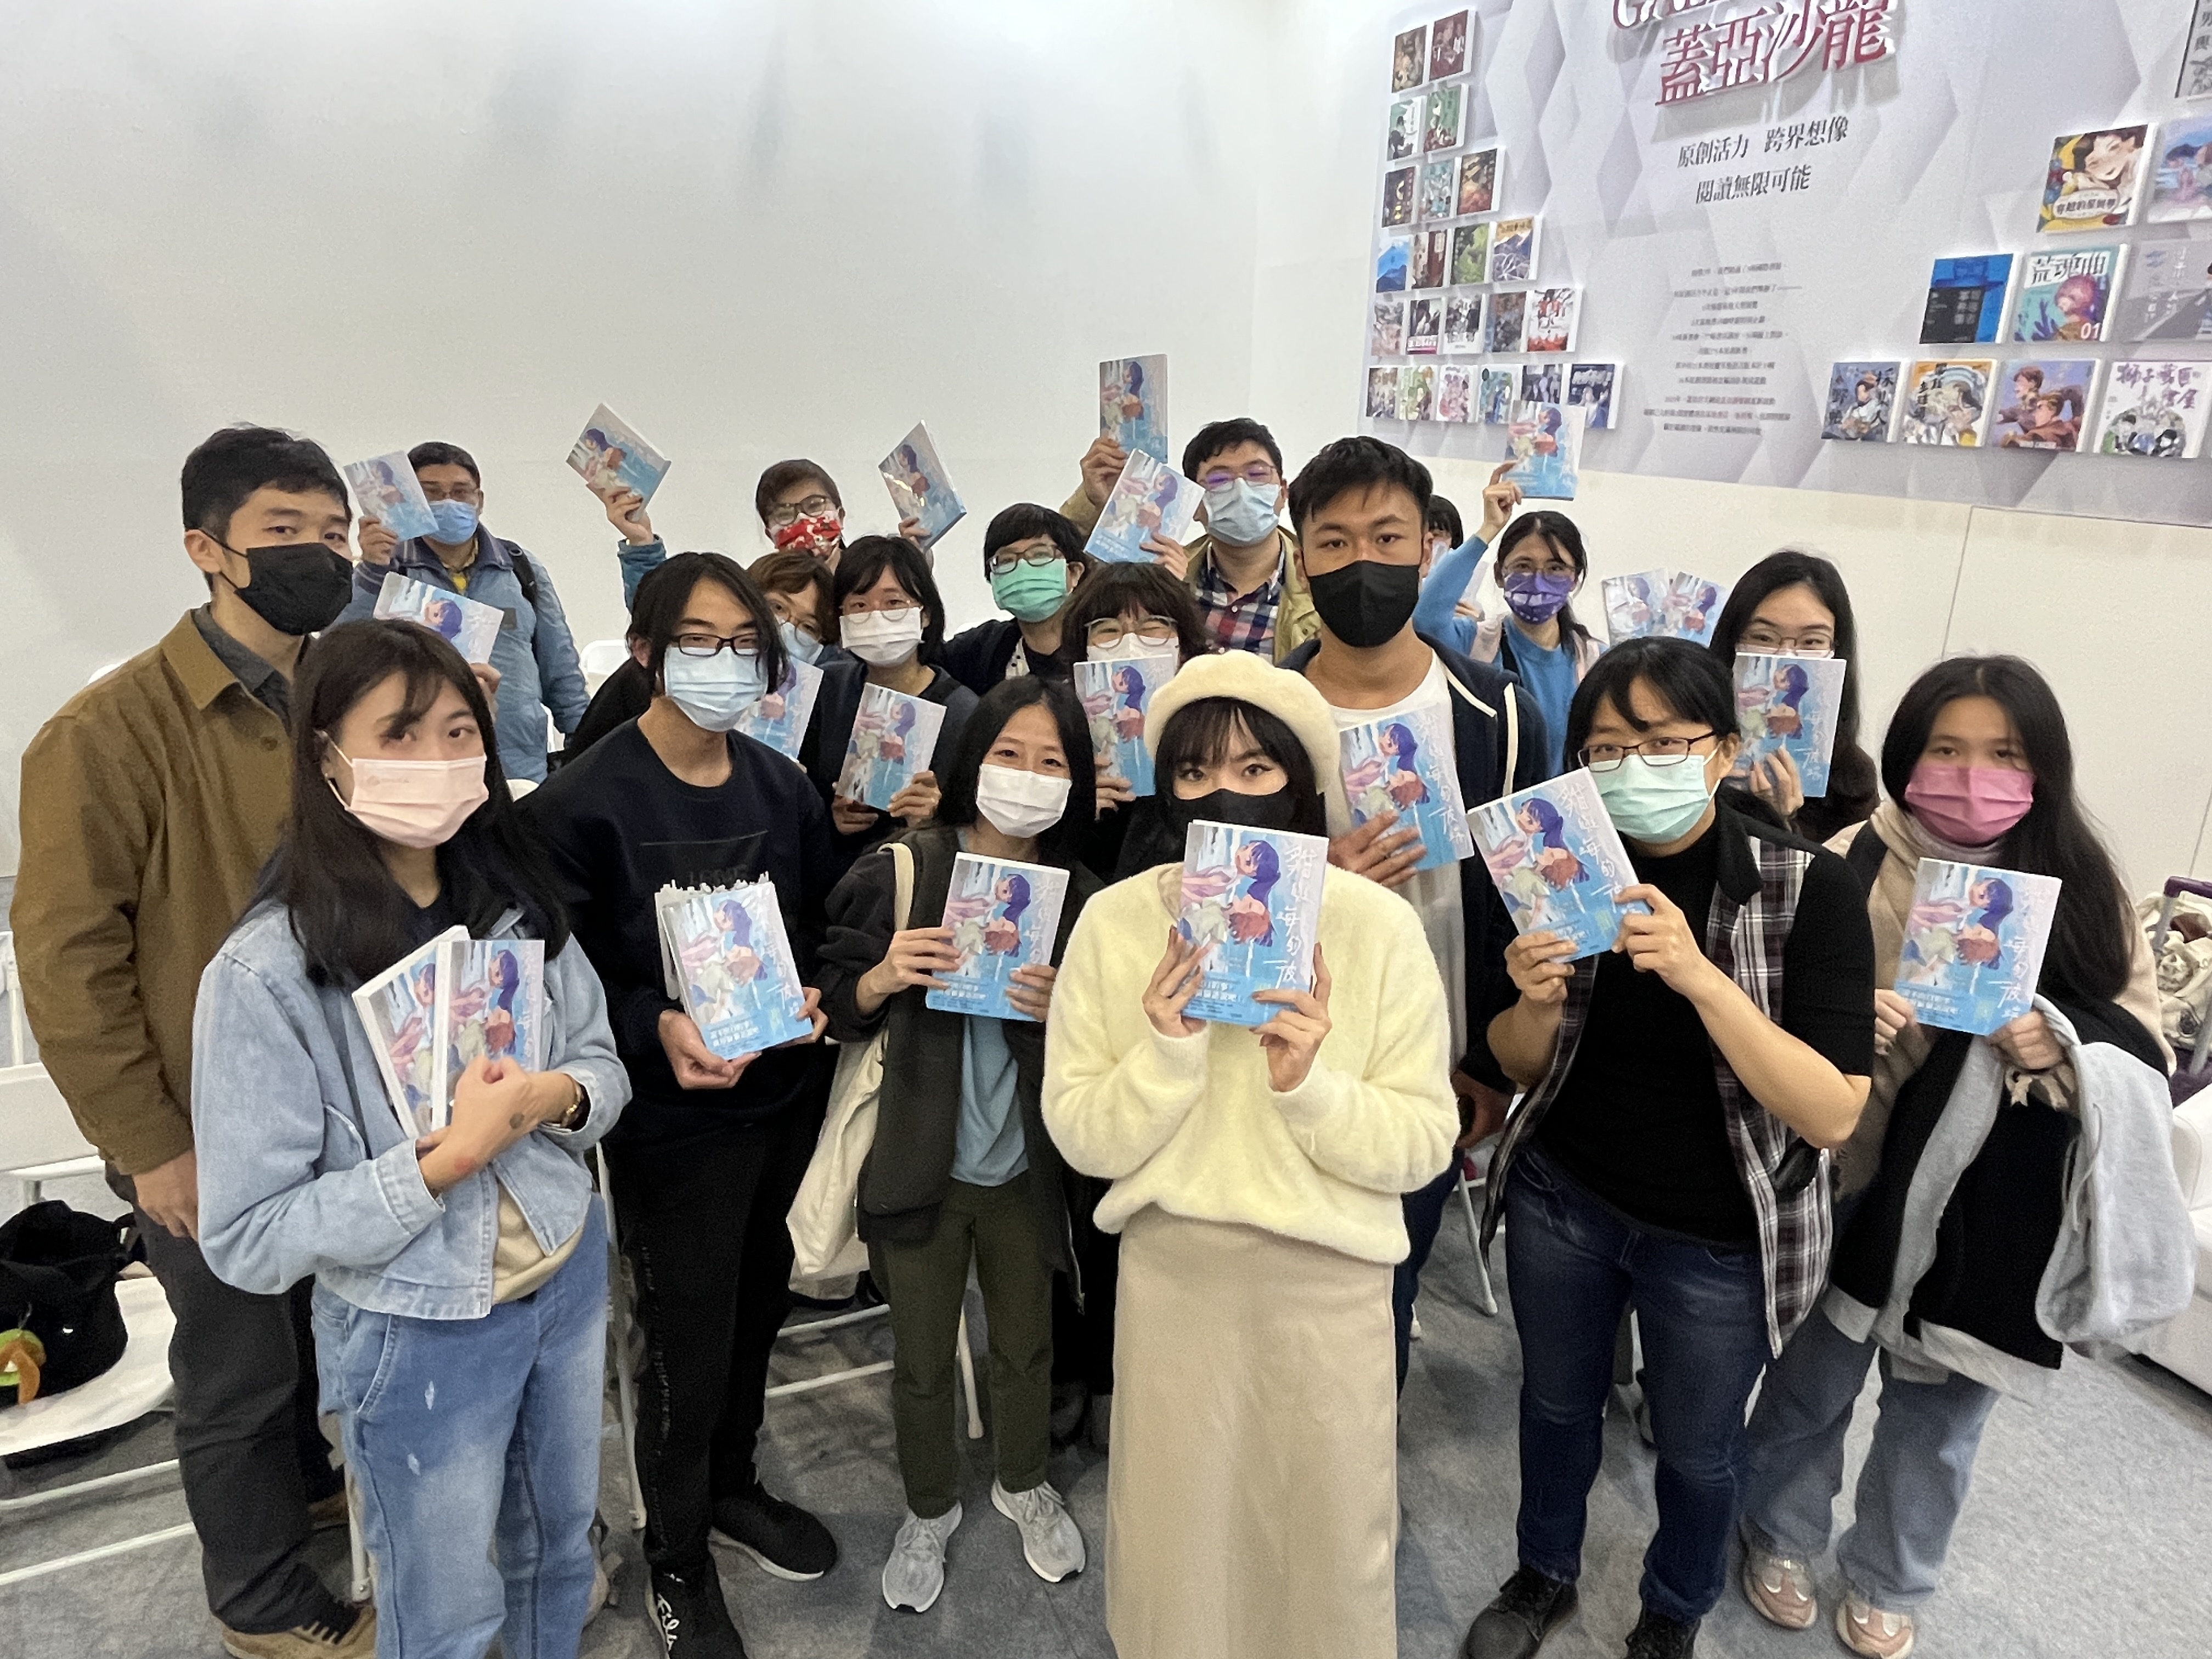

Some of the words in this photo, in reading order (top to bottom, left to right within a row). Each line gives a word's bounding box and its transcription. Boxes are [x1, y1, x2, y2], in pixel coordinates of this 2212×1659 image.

[1655, 0, 1890, 105] 蓋亞沙龍
[1678, 134, 1749, 168] 原創活力
[1764, 116, 1849, 152] 跨界想像
[1696, 164, 1812, 204] 閱讀無限可能
[2080, 323, 2101, 339] 01
[1559, 781, 1645, 915] 貓與海的彼
[1011, 875, 1062, 971] 貓與海的
[1263, 840, 1318, 990] 貓與海的彼
